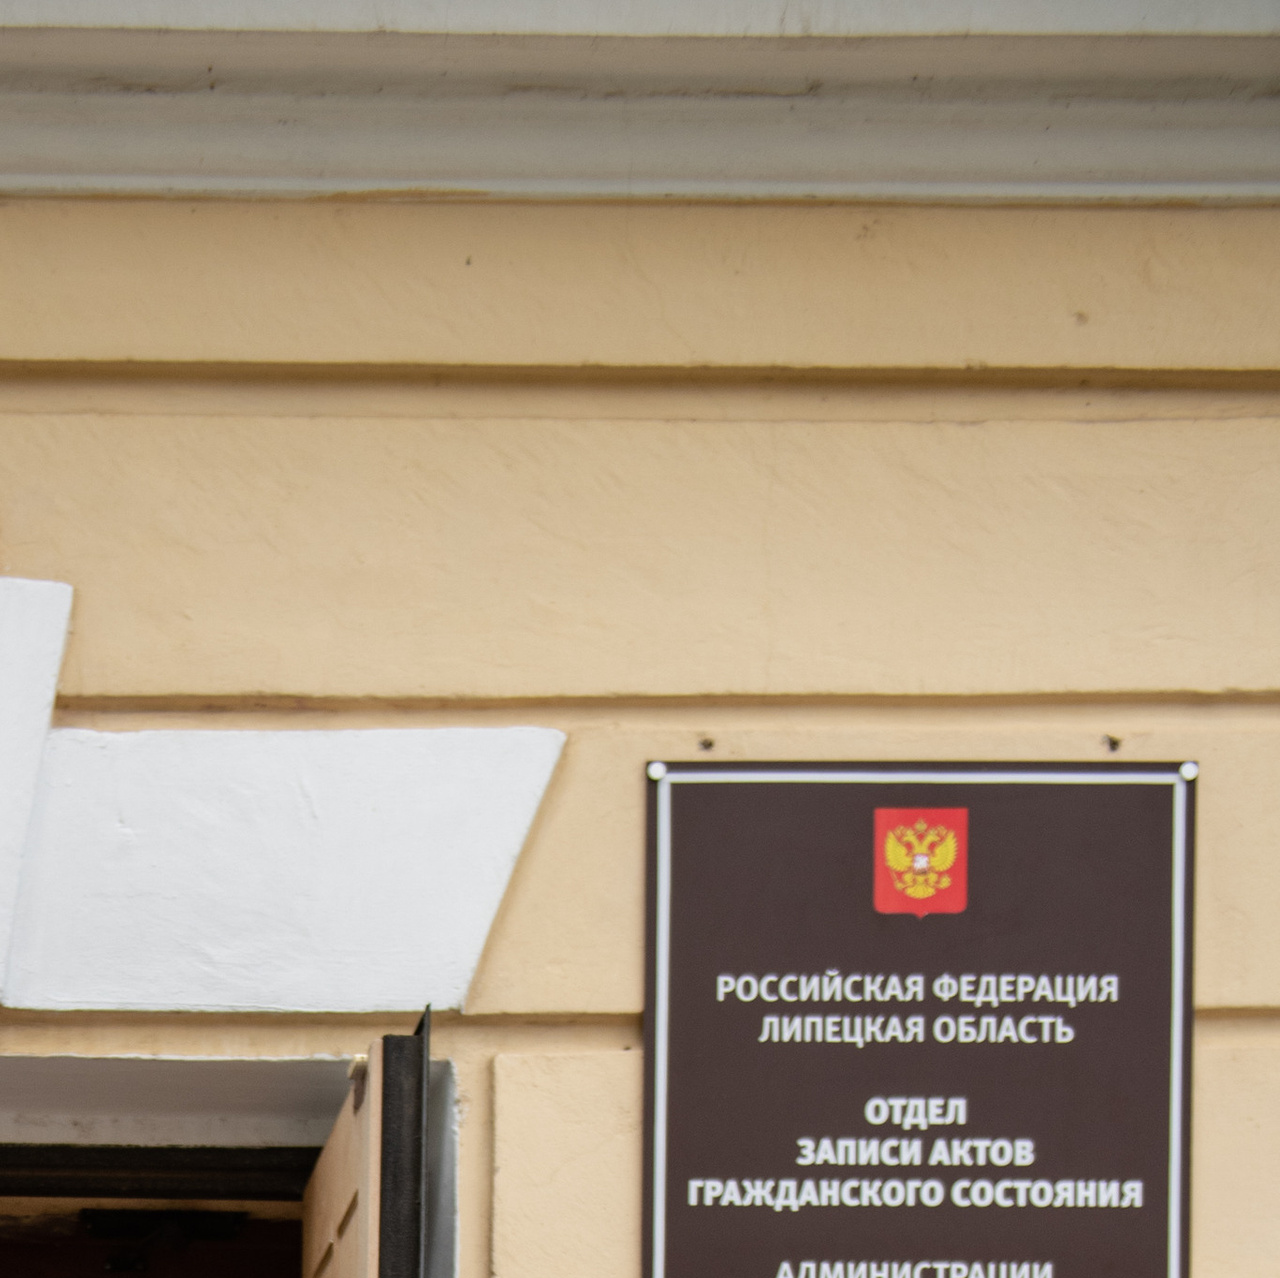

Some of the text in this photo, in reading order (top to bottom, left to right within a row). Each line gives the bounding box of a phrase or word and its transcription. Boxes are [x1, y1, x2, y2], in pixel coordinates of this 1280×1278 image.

[717, 969, 1118, 1007] РОССИЙСКАЯ ФЕДЕРАЦИЯ
[759, 1016, 1074, 1048] ЛИПЕЦКАЯ ОБЛАСТЬ
[865, 1098, 966, 1130] ОТДЕЛ
[797, 1138, 1034, 1166] ЗАПИСИ АКТОВ
[689, 1179, 1142, 1211] ГРАЖДАНСКОГО СОСТОЯНИЯ
